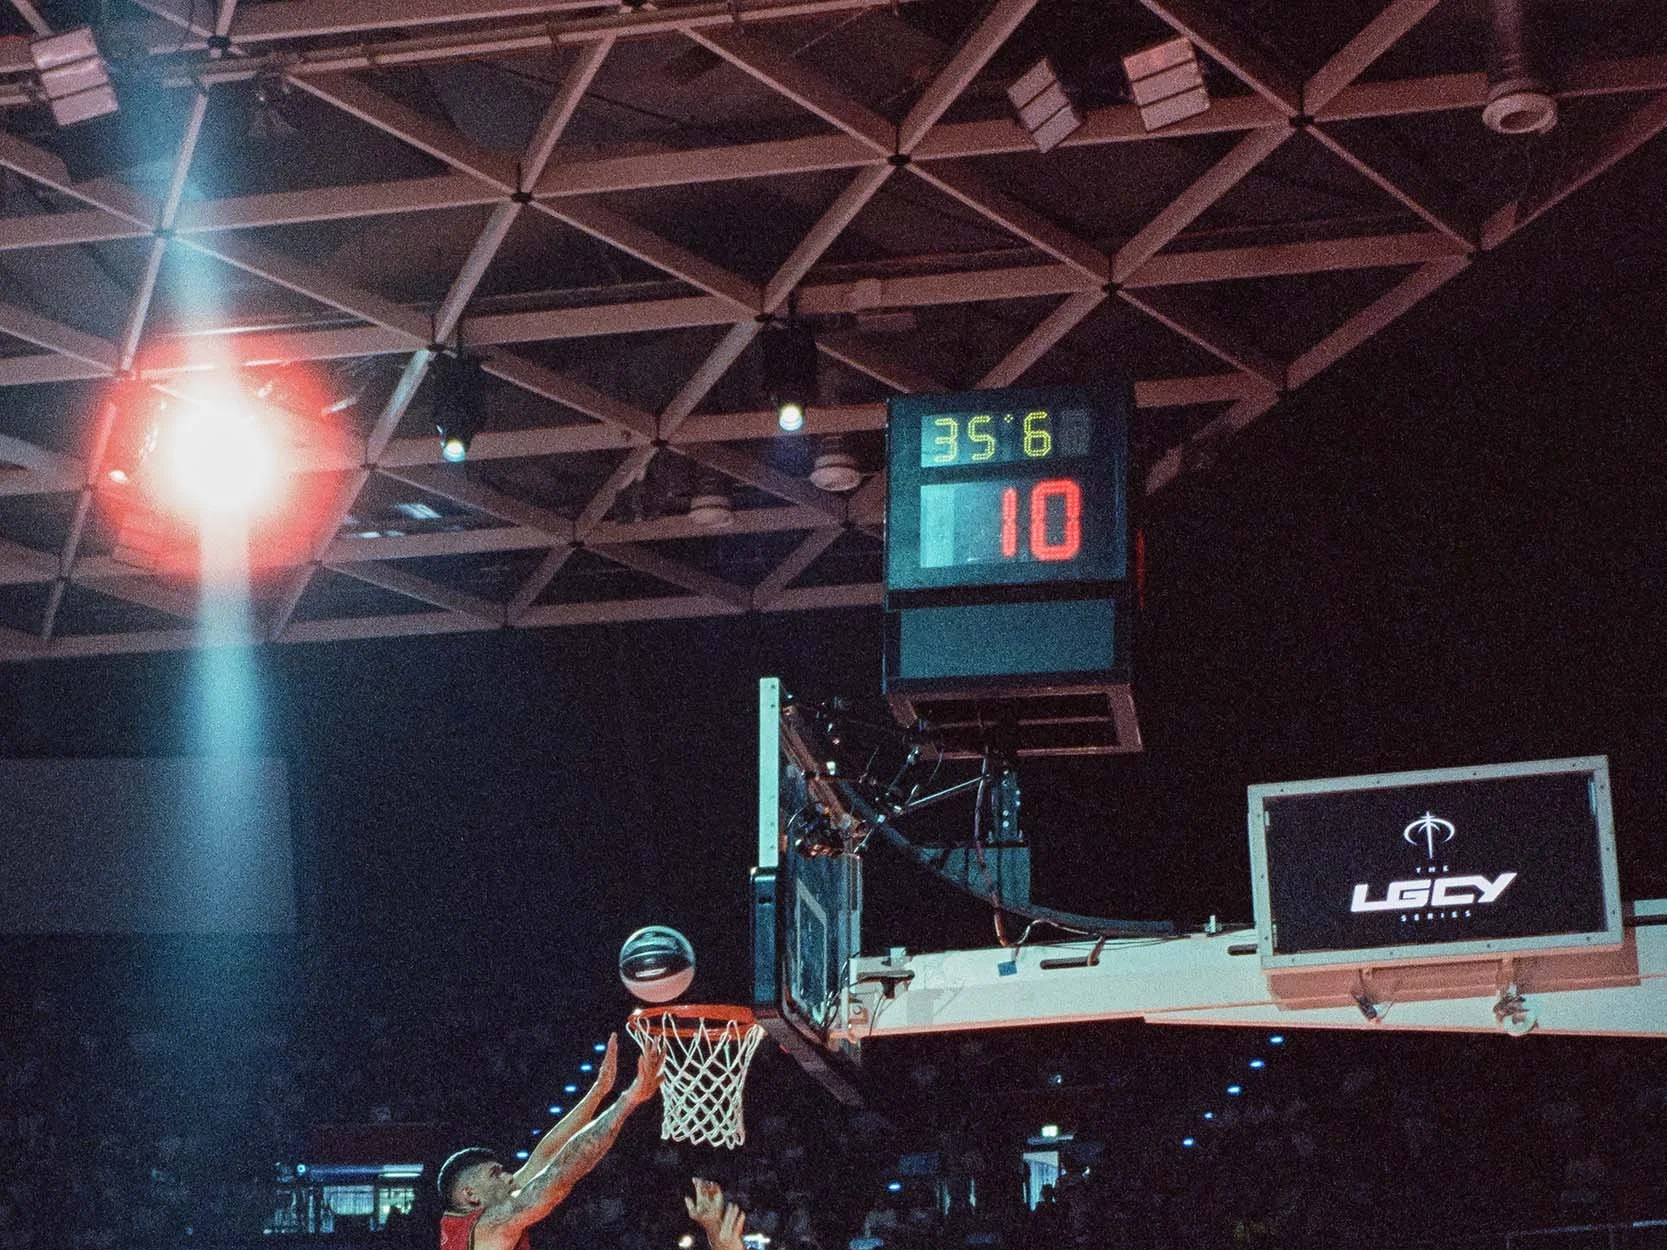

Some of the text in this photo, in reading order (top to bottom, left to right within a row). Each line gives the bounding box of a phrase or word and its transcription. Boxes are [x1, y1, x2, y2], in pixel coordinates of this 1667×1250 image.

[1002, 478, 1082, 562] 10
[1416, 865, 1449, 874] THE
[1351, 872, 1517, 912] LGCY
[1401, 910, 1472, 922] SERIES
